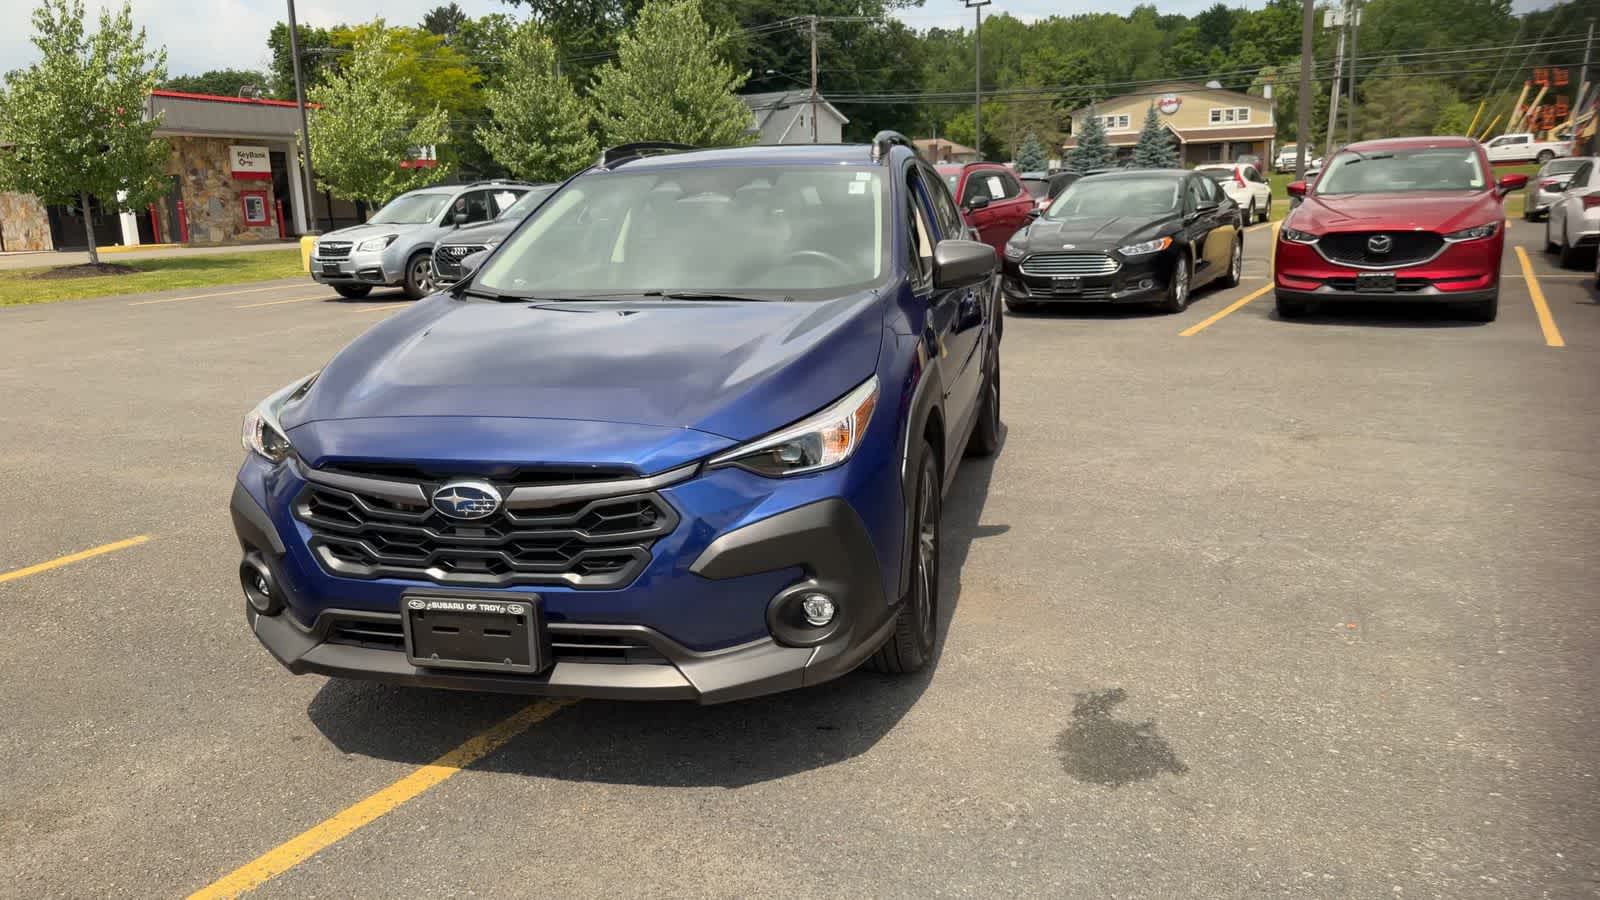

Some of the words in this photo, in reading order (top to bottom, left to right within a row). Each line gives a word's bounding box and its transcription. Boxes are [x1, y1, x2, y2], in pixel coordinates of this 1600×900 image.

[237, 151, 266, 159] KeyBank
[431, 601, 465, 610] SUBARU
[466, 602, 477, 611] OF
[479, 603, 501, 612] TROY
